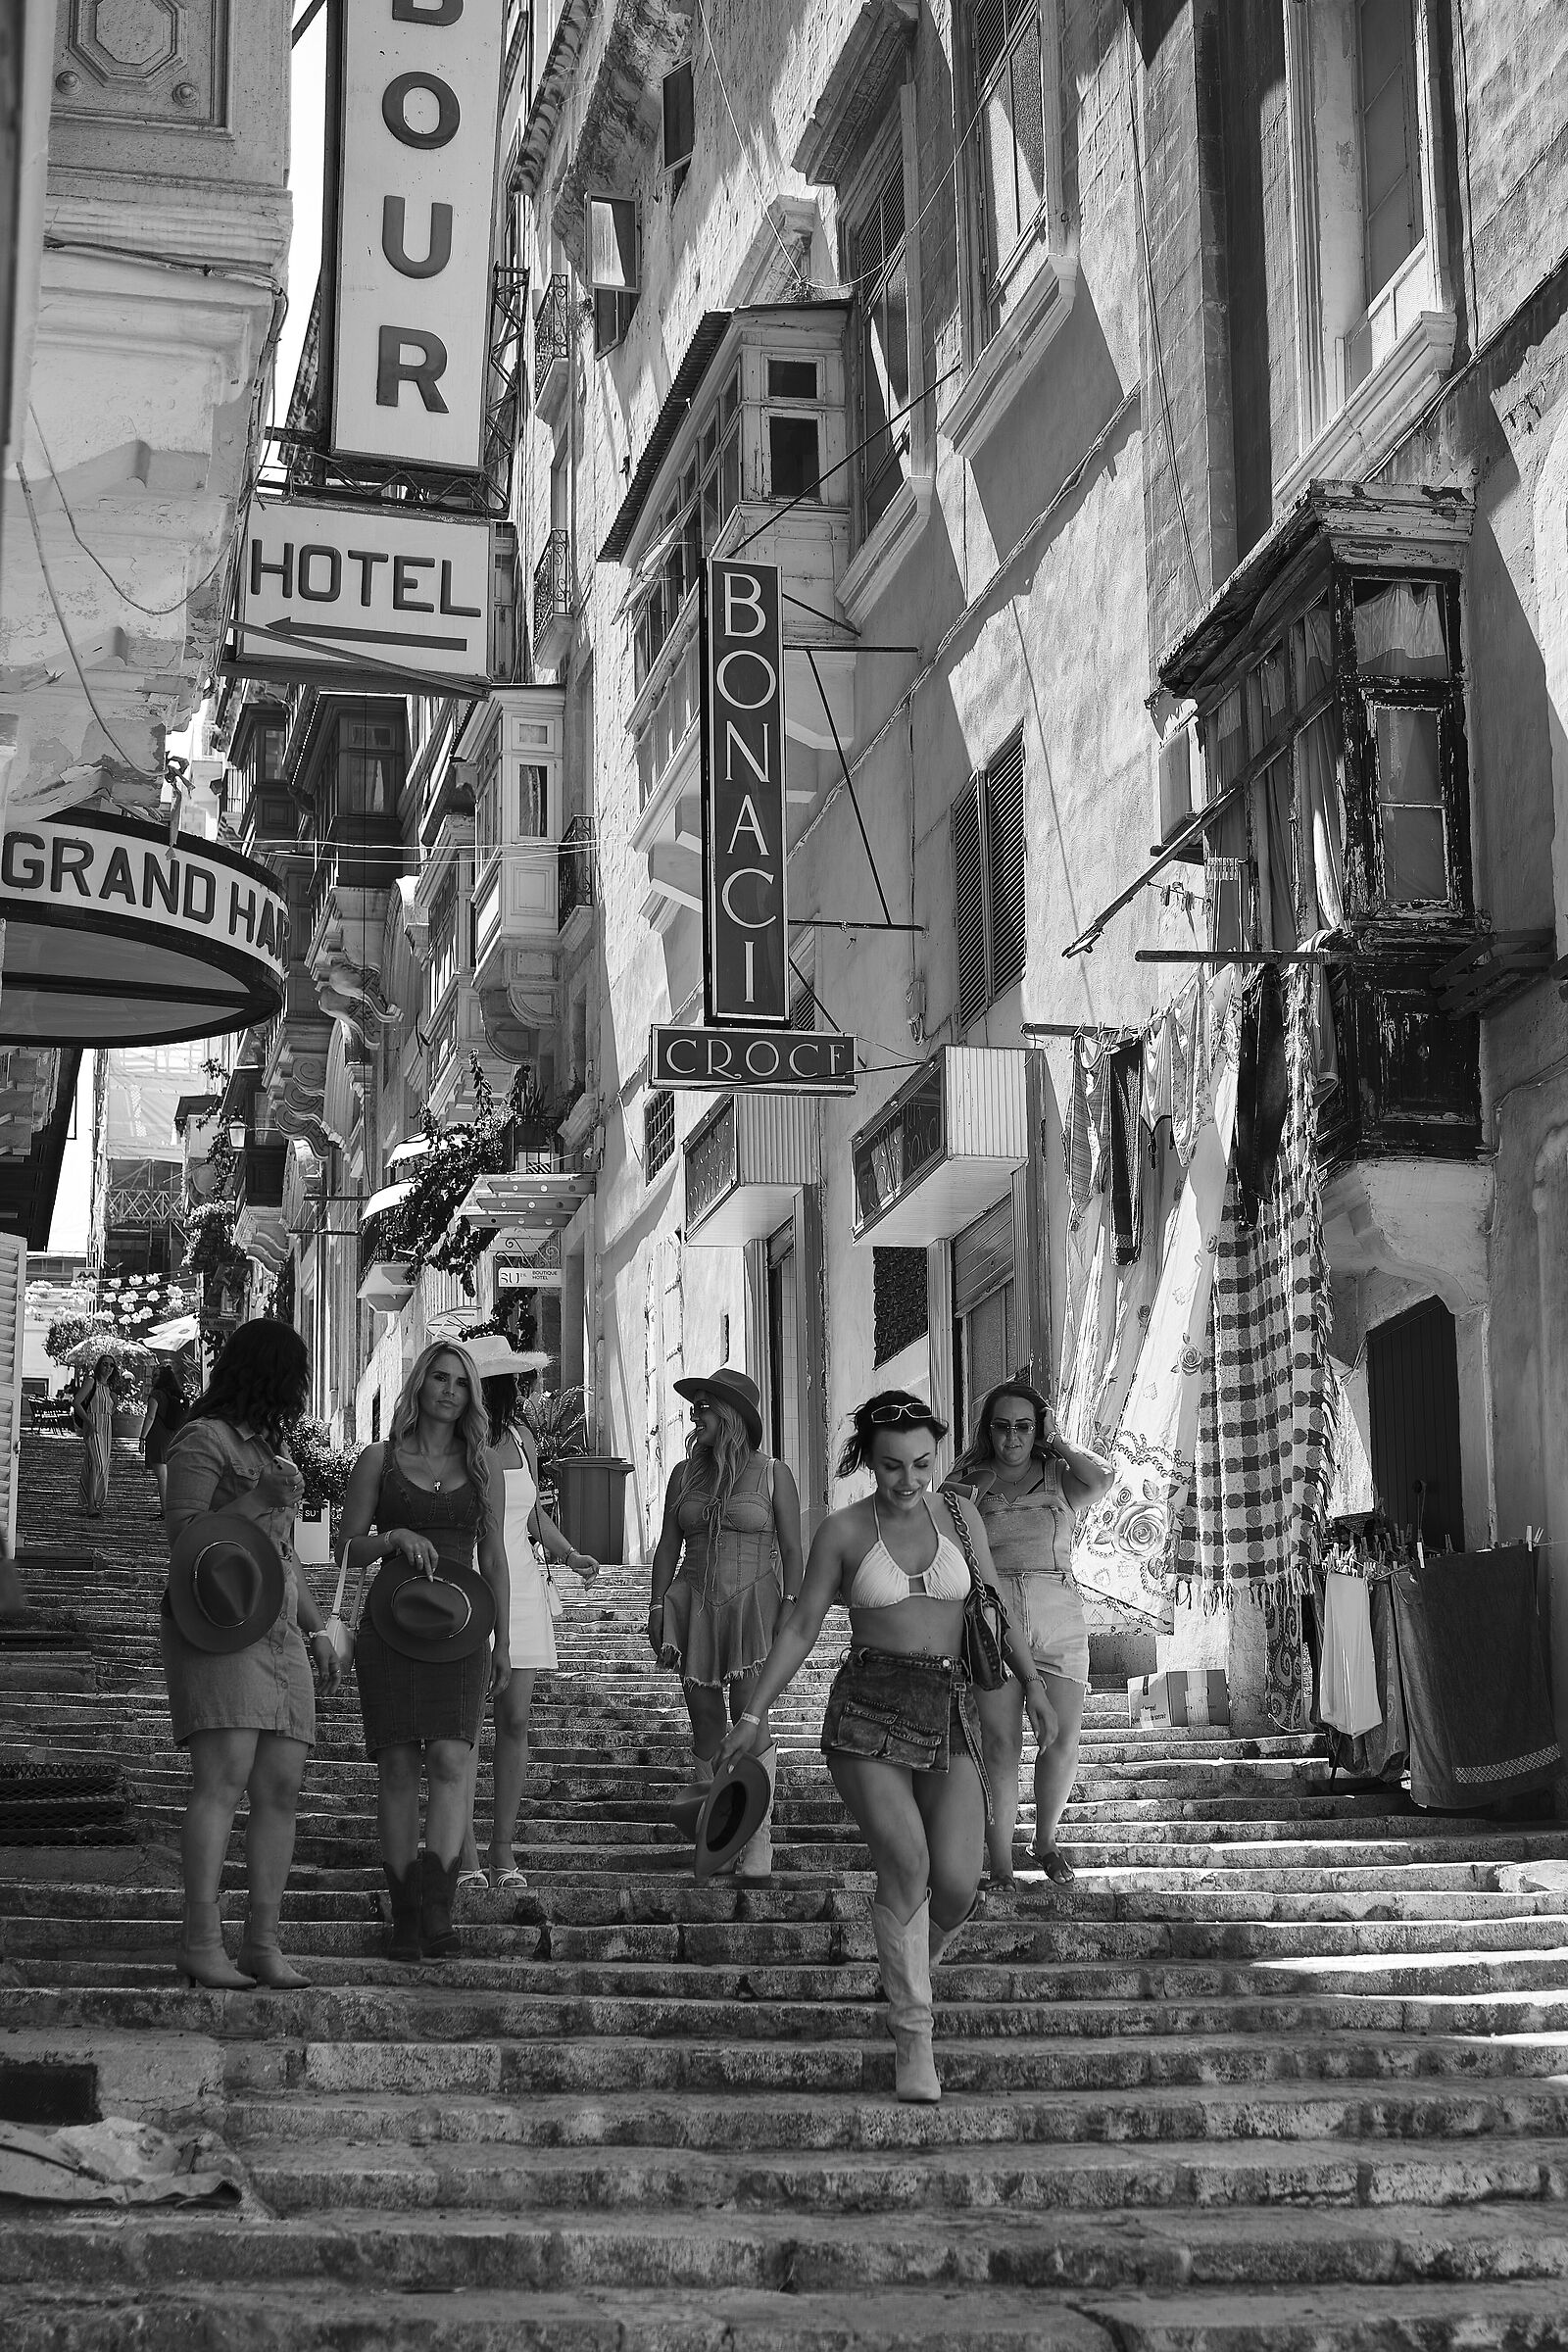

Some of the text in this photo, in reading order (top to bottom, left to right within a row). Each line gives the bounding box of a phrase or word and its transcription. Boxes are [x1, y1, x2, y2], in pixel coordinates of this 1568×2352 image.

[251, 539, 481, 617] HOTEL
[716, 572, 777, 1003] BONACI
[1, 831, 216, 924] GRAND
[666, 1039, 845, 1079] CROCE
